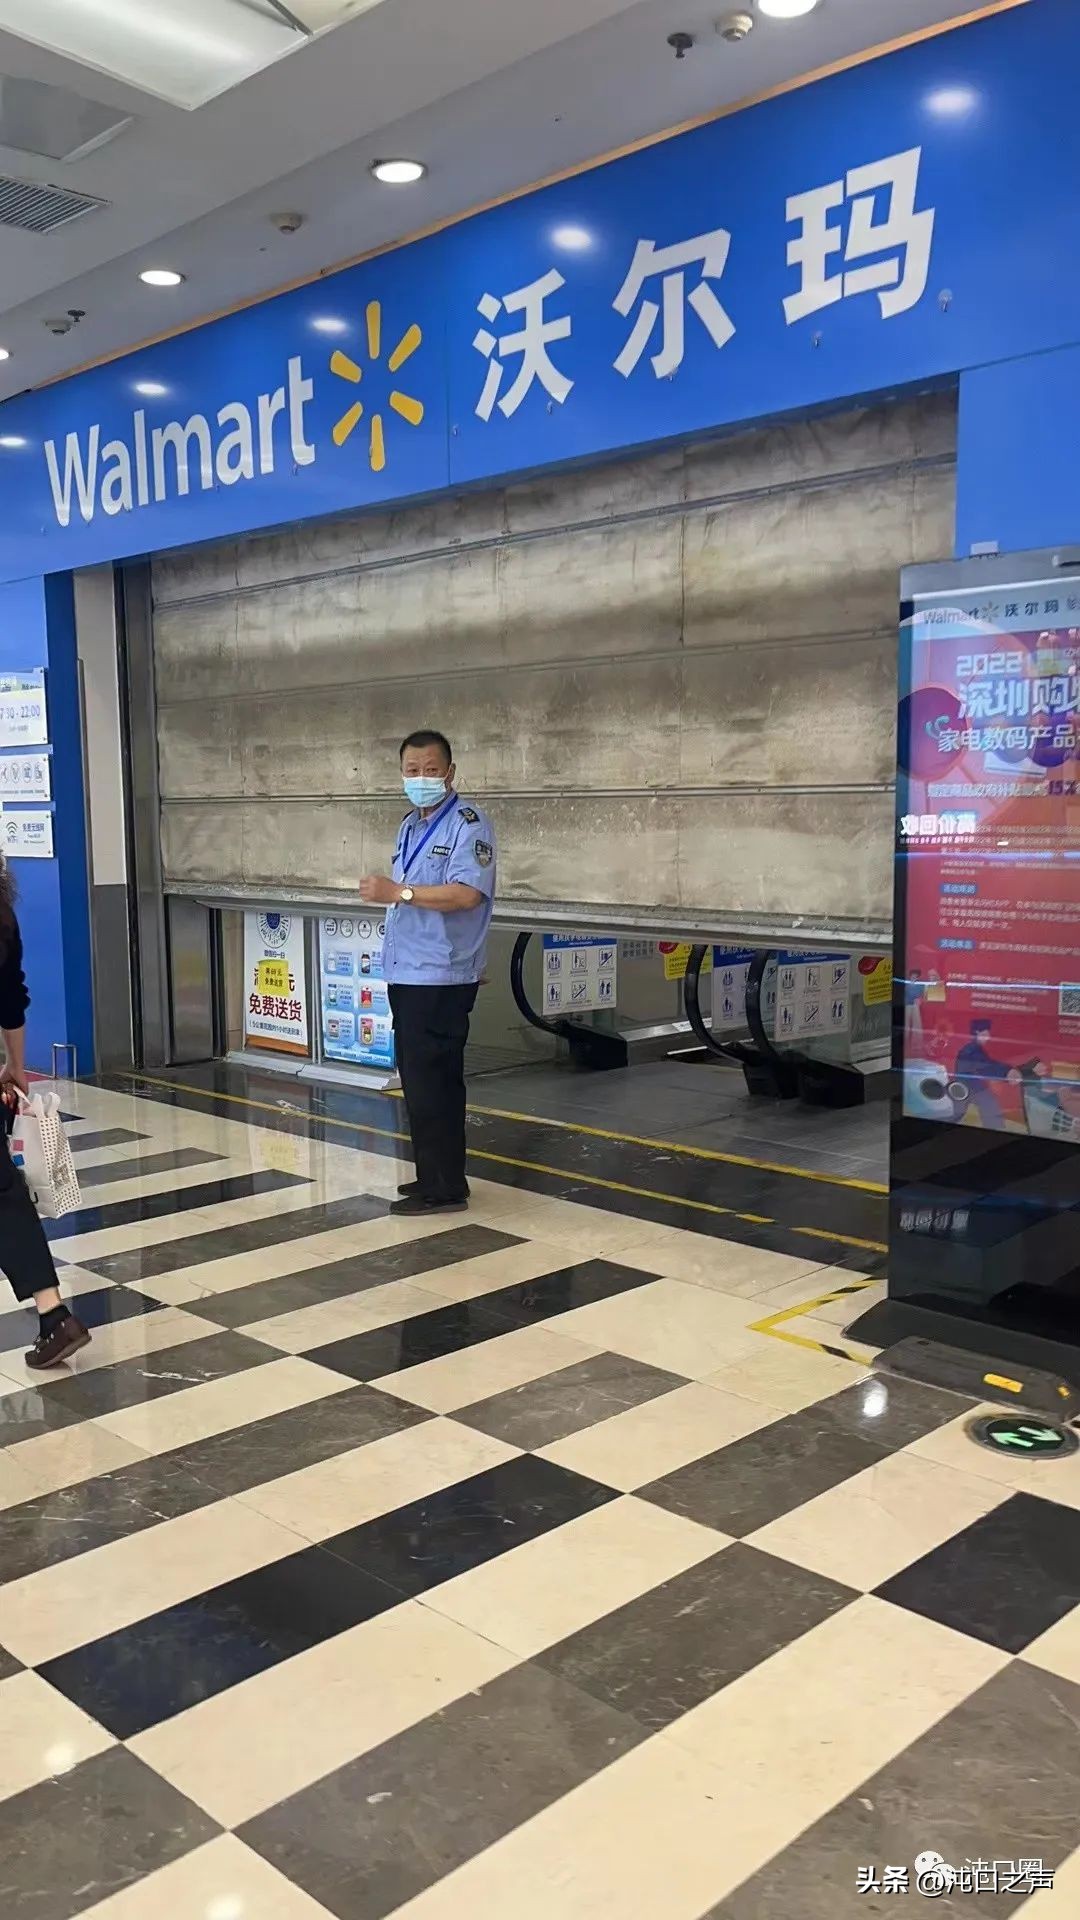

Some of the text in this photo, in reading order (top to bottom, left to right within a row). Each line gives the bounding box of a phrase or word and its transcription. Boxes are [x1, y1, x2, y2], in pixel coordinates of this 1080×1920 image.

[473, 146, 936, 421] 沃尔玛
[44, 356, 317, 528] Walmart
[938, 725, 1080, 752] 家电数码产品
[249, 993, 303, 1023] 免费送货
